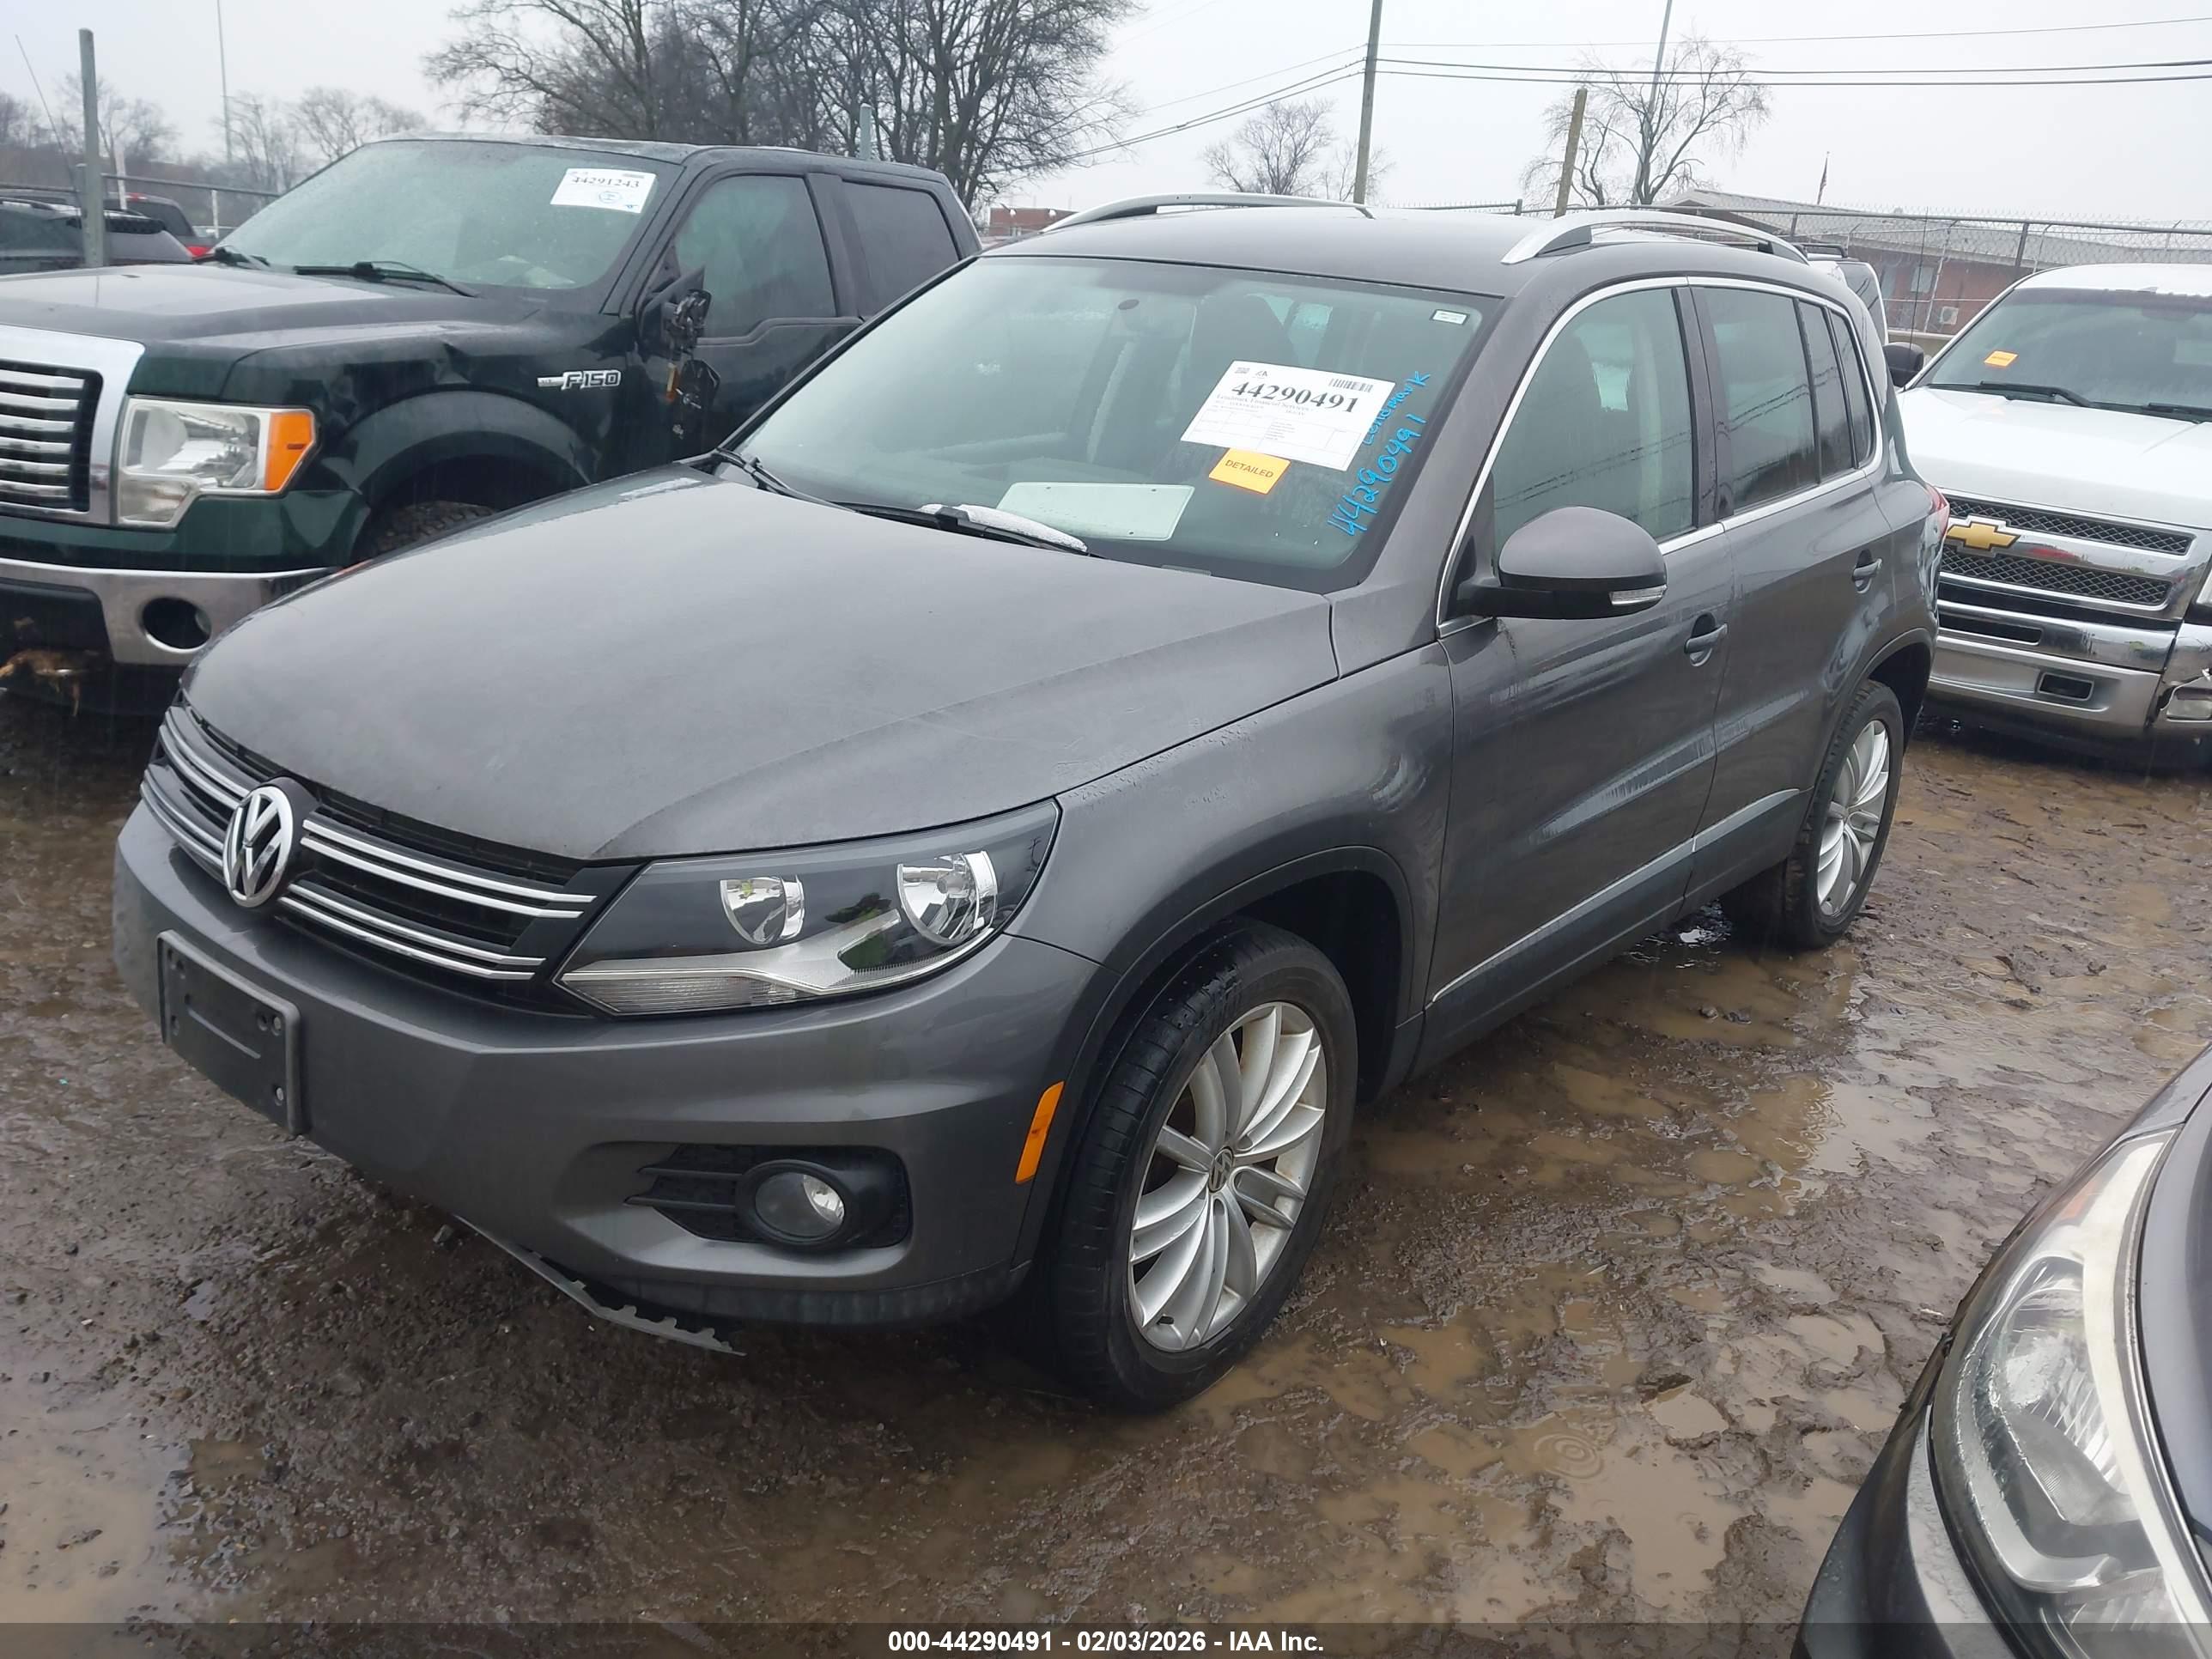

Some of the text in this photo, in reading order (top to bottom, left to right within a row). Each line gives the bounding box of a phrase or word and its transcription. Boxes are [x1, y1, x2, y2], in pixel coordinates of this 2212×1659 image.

[571, 176, 640, 189] 44291243
[1231, 381, 1358, 413] 44290491
[1224, 459, 1275, 478] DETAILED
[1327, 413, 1427, 537] 44290491
